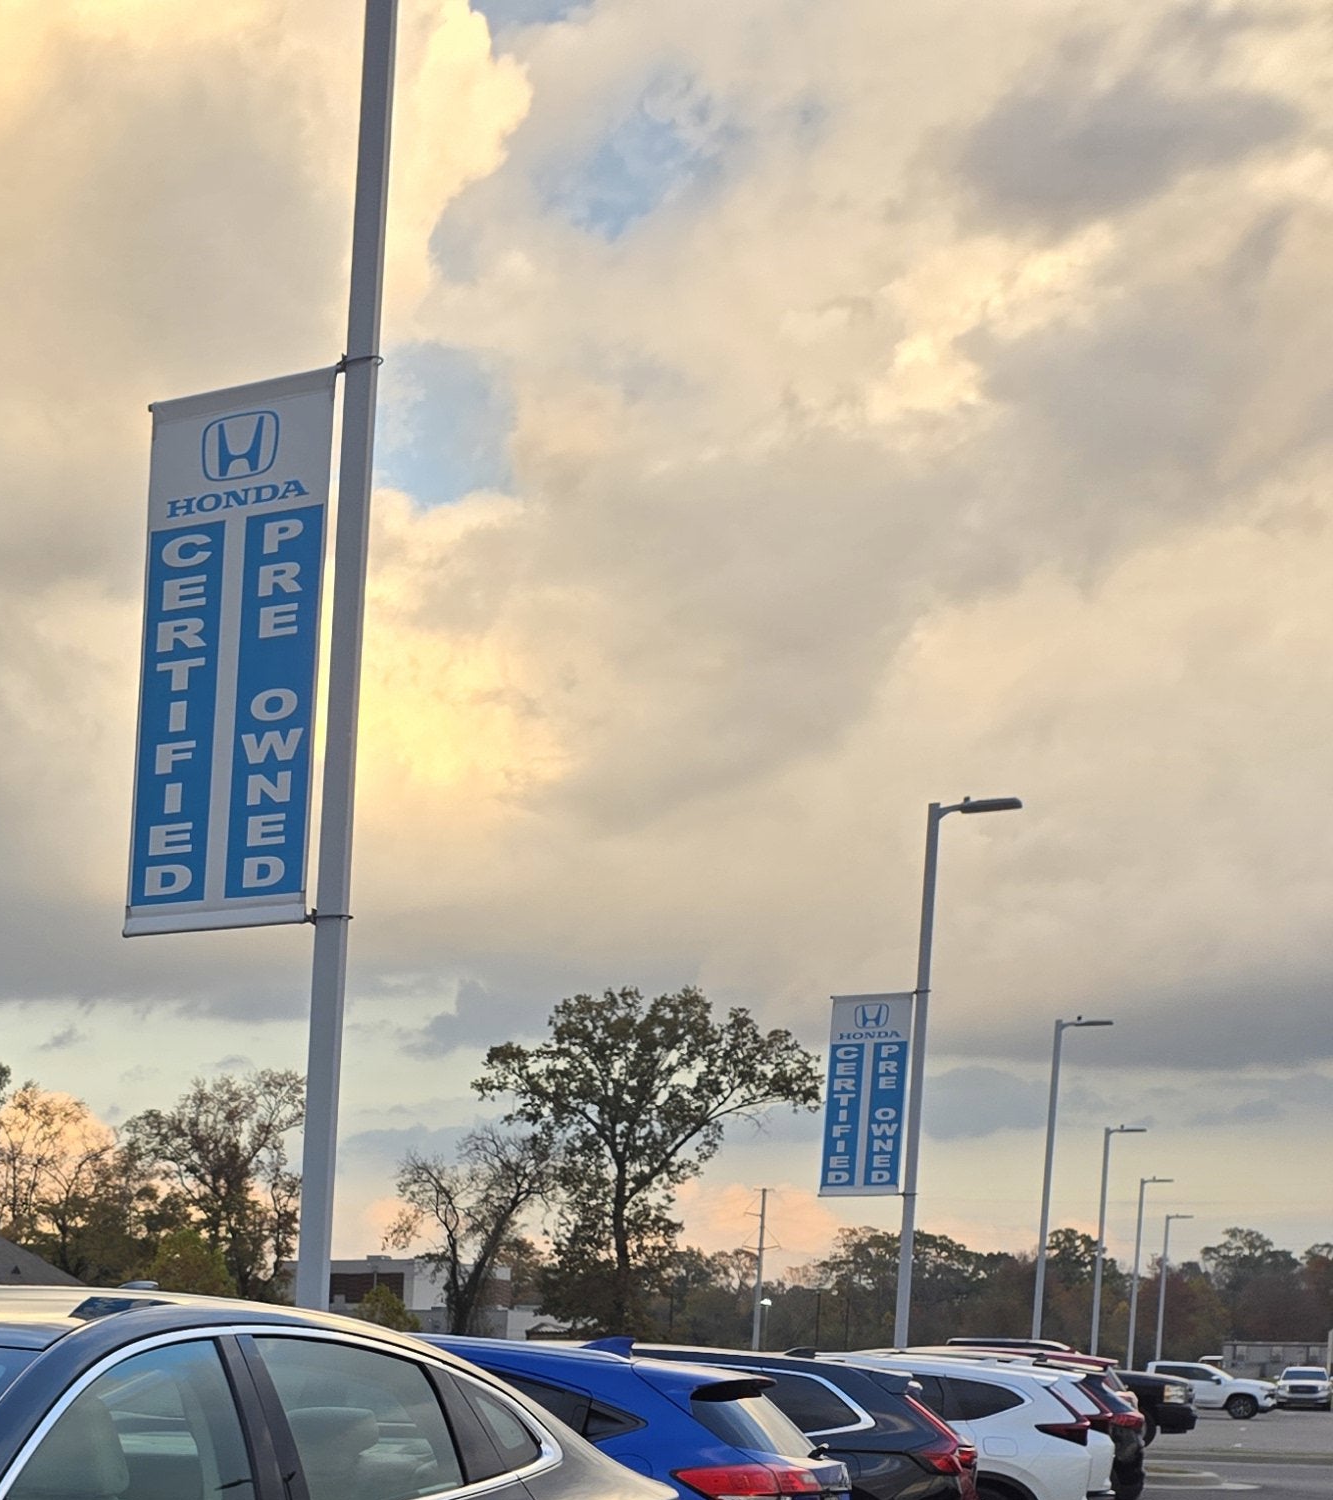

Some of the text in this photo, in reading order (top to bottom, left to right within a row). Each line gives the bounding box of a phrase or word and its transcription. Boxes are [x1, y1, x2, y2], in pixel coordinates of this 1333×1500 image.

[166, 480, 310, 518] HONDA
[144, 533, 212, 897] CERTIFIED
[241, 518, 304, 889] PRE OWNED
[839, 1031, 901, 1041] HONDA
[828, 1047, 858, 1184] CERTIFIED
[871, 1045, 899, 1184] PRE OWNED
